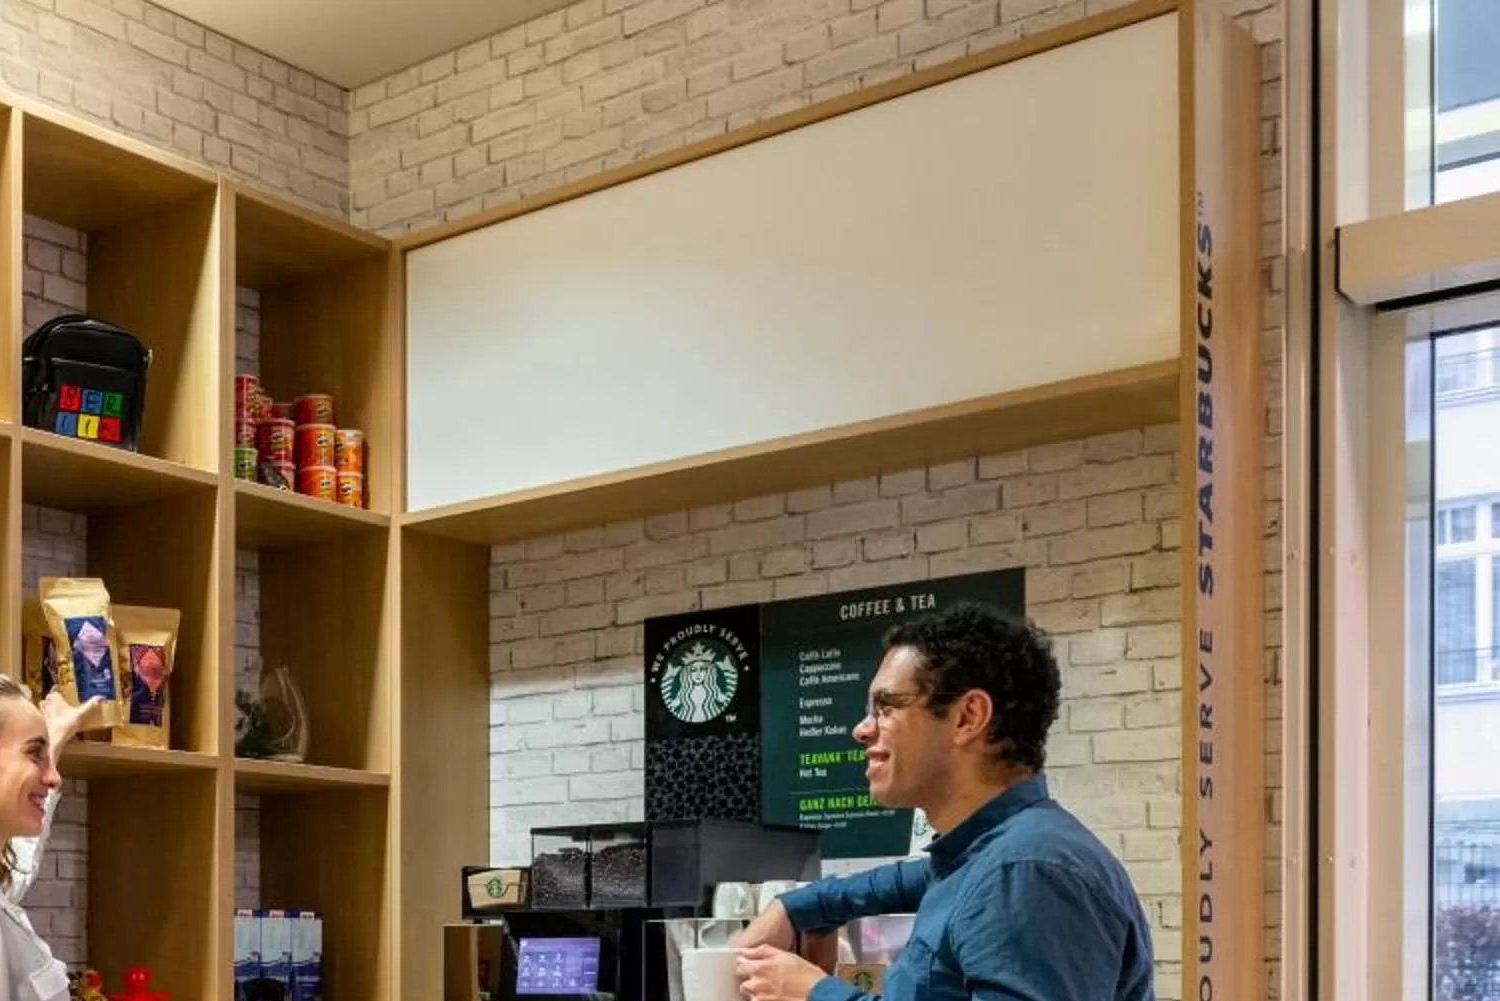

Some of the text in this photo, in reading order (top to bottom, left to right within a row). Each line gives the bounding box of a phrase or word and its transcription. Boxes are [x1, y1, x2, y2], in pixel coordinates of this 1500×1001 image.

[1197, 222, 1213, 599] STARBUCKS
[651, 624, 749, 673] WE PROUDLY SERVE
[840, 593, 936, 621] COFFEE & TEA
[1199, 630, 1213, 800] SERVE
